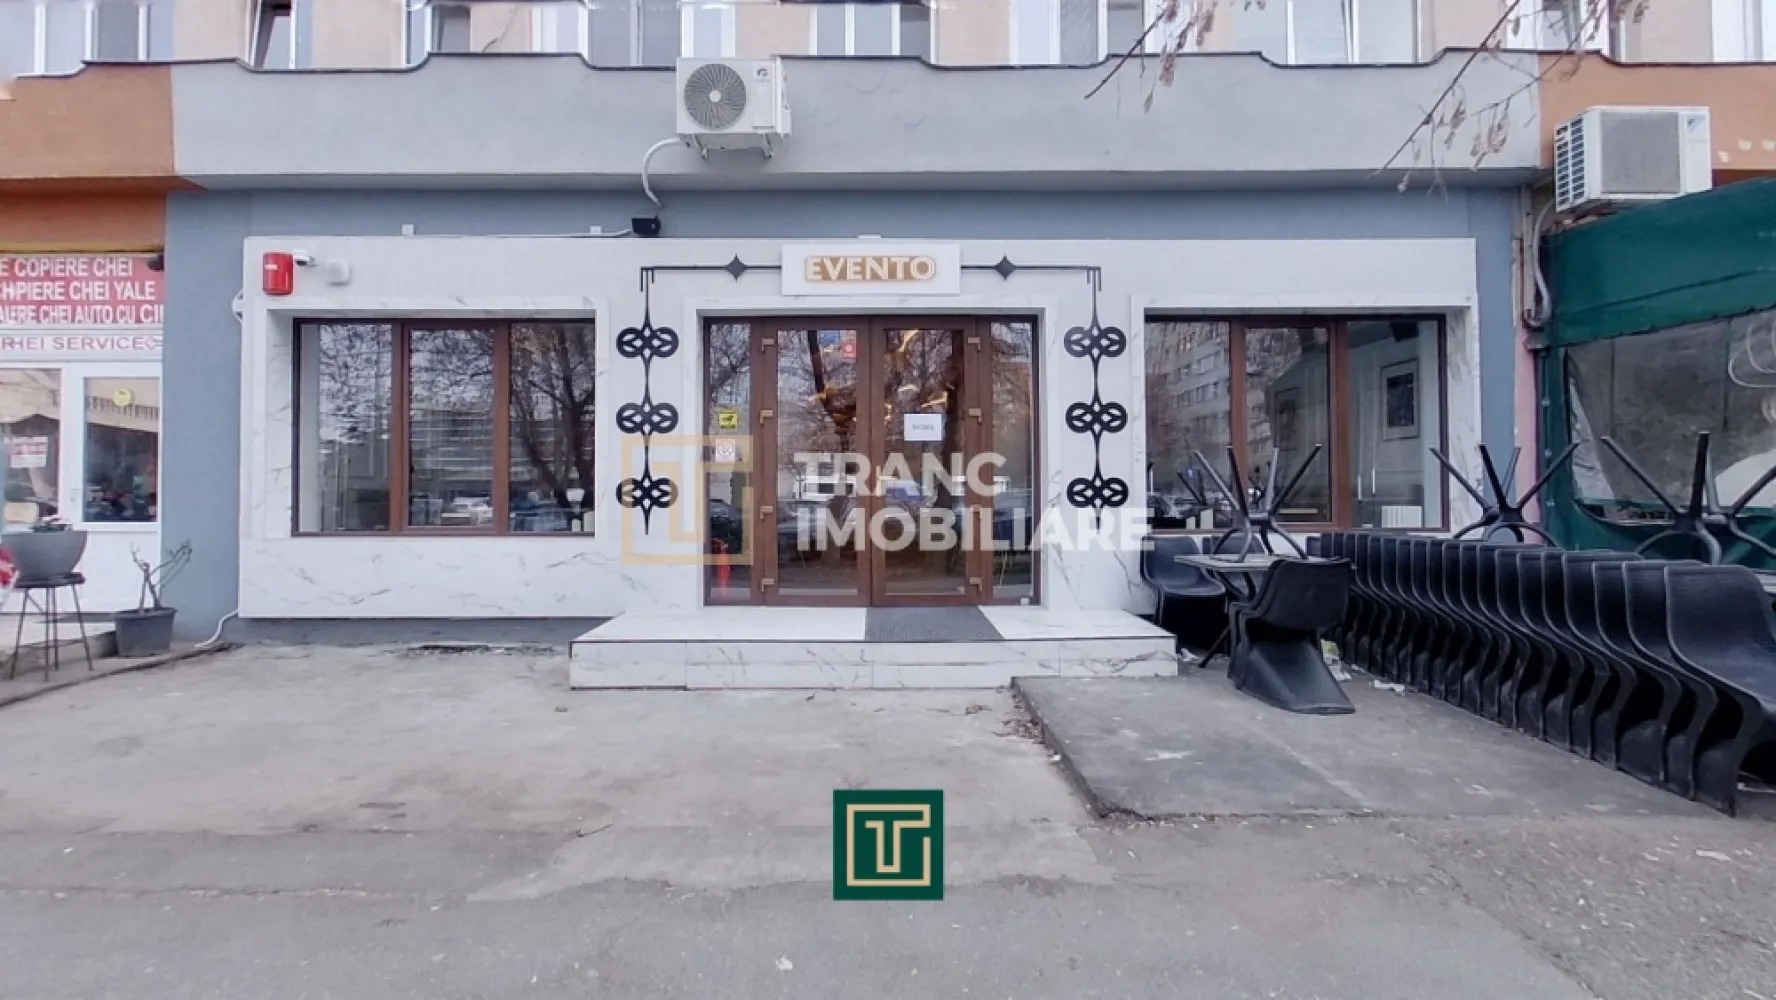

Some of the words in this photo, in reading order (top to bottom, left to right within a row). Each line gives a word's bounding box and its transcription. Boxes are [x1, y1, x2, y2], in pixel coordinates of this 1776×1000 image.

[14, 257, 89, 277] COPIERE
[92, 257, 133, 277] CHEI
[805, 256, 936, 281] EVENTO
[69, 281, 109, 300] CHEI
[114, 281, 156, 300] YALE
[38, 304, 71, 324] CHEI
[75, 304, 113, 324] AUTO
[116, 304, 136, 324] CU
[52, 337, 145, 350] SERVICE
